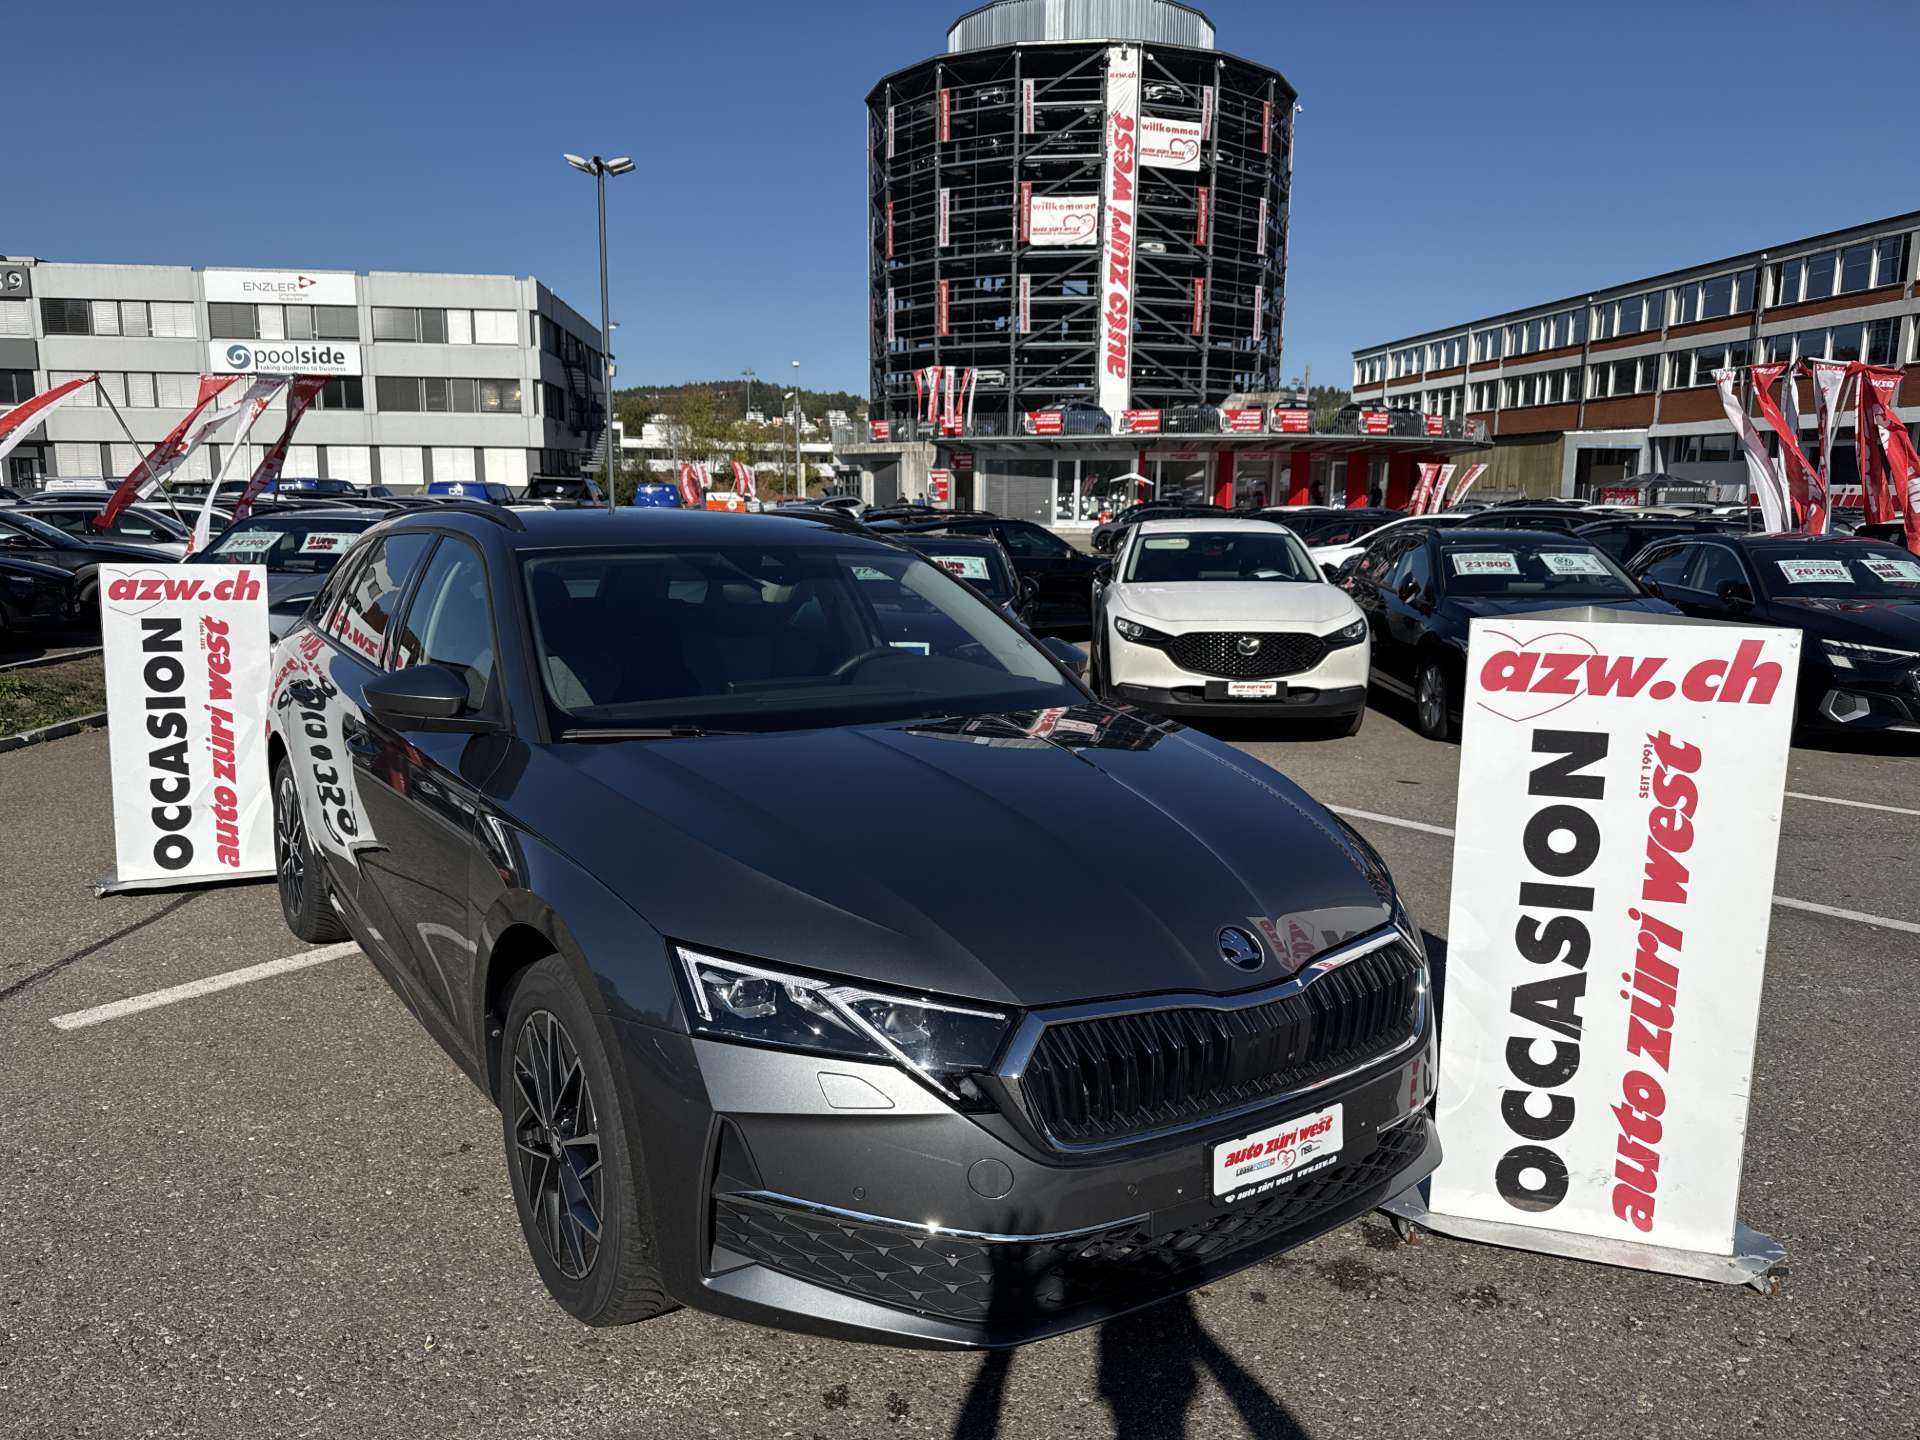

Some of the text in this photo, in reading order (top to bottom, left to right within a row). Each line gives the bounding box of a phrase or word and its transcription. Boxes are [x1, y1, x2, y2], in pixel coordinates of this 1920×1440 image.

[1141, 122, 1200, 136] willkommen
[1032, 202, 1097, 211] willkommen
[1104, 111, 1135, 380] auto züri west
[0, 272, 23, 291] 9
[243, 281, 297, 293] ENZLER
[254, 345, 345, 370] poolside
[260, 364, 281, 372] taking
[1465, 560, 1512, 568] 23'800
[1794, 568, 1844, 576] 26'300
[107, 569, 261, 601] azw.ch
[1479, 639, 1783, 705] azw.ch
[140, 617, 194, 870] OCCASION
[200, 614, 241, 868] auto züri west
[1639, 743, 1654, 799] SEIT 1991
[1494, 728, 1611, 1214] OCCASION
[1610, 730, 1702, 1234] auto züri west
[1224, 1115, 1334, 1168] auto züri west
[1237, 1188, 1256, 1200] auto
[1275, 1173, 1294, 1186] west
